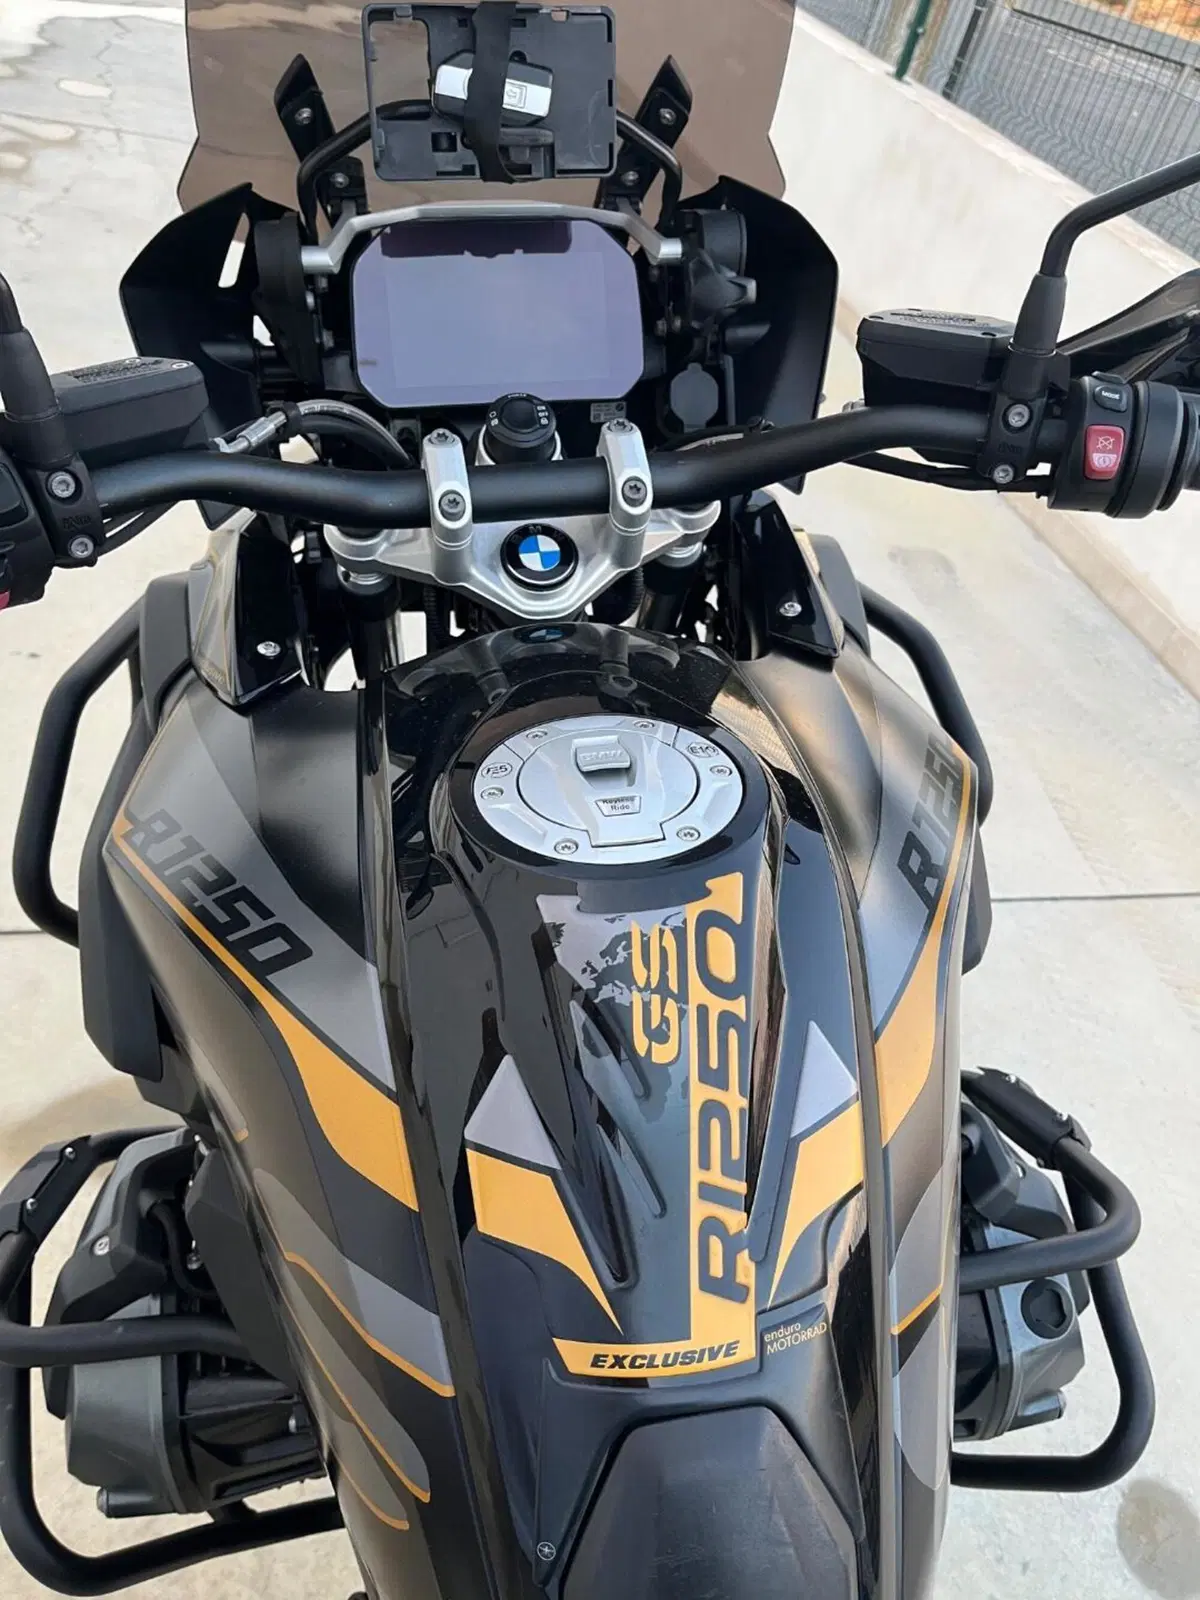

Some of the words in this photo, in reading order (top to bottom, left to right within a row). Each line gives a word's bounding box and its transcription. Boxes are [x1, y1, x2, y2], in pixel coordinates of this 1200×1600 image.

[121, 808, 314, 977] R1250
[630, 919, 679, 1065] GS
[694, 909, 750, 1304] R1250
[590, 1340, 740, 1369] EXCLUSIVE
[763, 1322, 801, 1342] enduro
[766, 1322, 827, 1355] MOTORRAD
